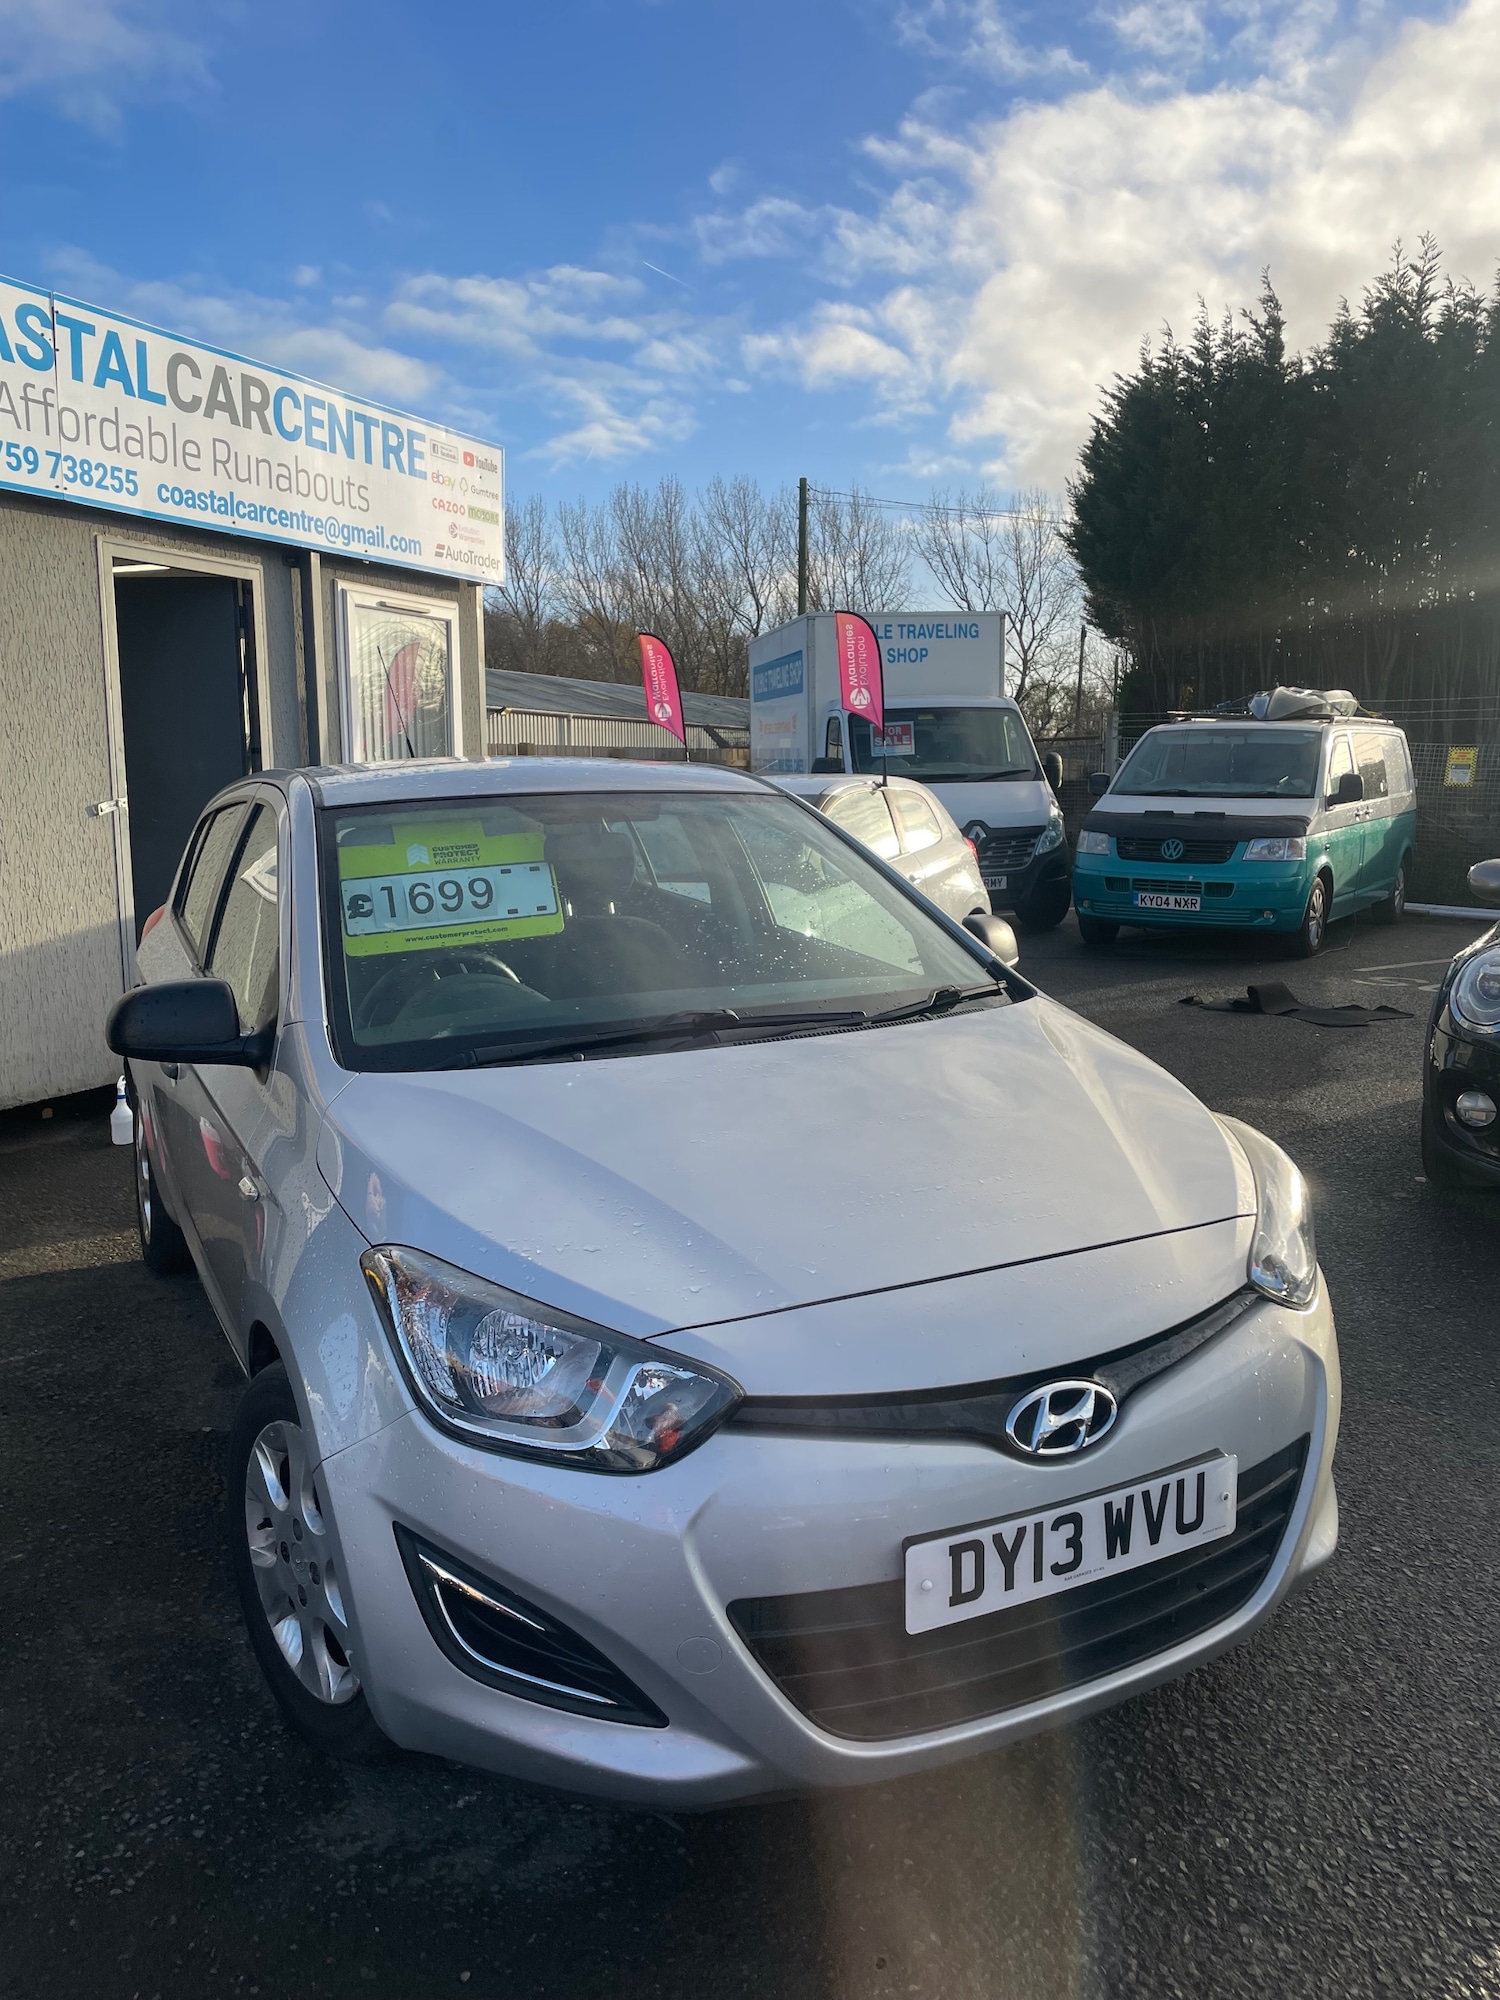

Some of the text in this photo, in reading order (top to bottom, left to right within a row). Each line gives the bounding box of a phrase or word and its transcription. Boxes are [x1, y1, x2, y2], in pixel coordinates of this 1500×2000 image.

[0, 440, 138, 496] 59 738255
[475, 455, 498, 474] YouTube
[212, 437, 370, 512] Runabouts
[431, 469, 456, 491] ebay
[471, 484, 499, 501] Gumtree
[432, 497, 466, 516] CAZOO
[157, 483, 422, 556] coastalcarcentre@gmail.com
[445, 545, 500, 570] AutoTrader
[898, 623, 979, 639] TRAVELING
[887, 647, 929, 663] SHOP
[874, 735, 911, 746] SALE
[432, 843, 478, 852] CUSTOMER
[433, 848, 479, 859] PROTECT
[434, 855, 480, 865] WARRANTY
[347, 877, 493, 919] £1699
[1140, 894, 1198, 909] KY04 NXR
[405, 926, 508, 943] www.customerprotect.com
[948, 1472, 1205, 1608] DY13 WVU
